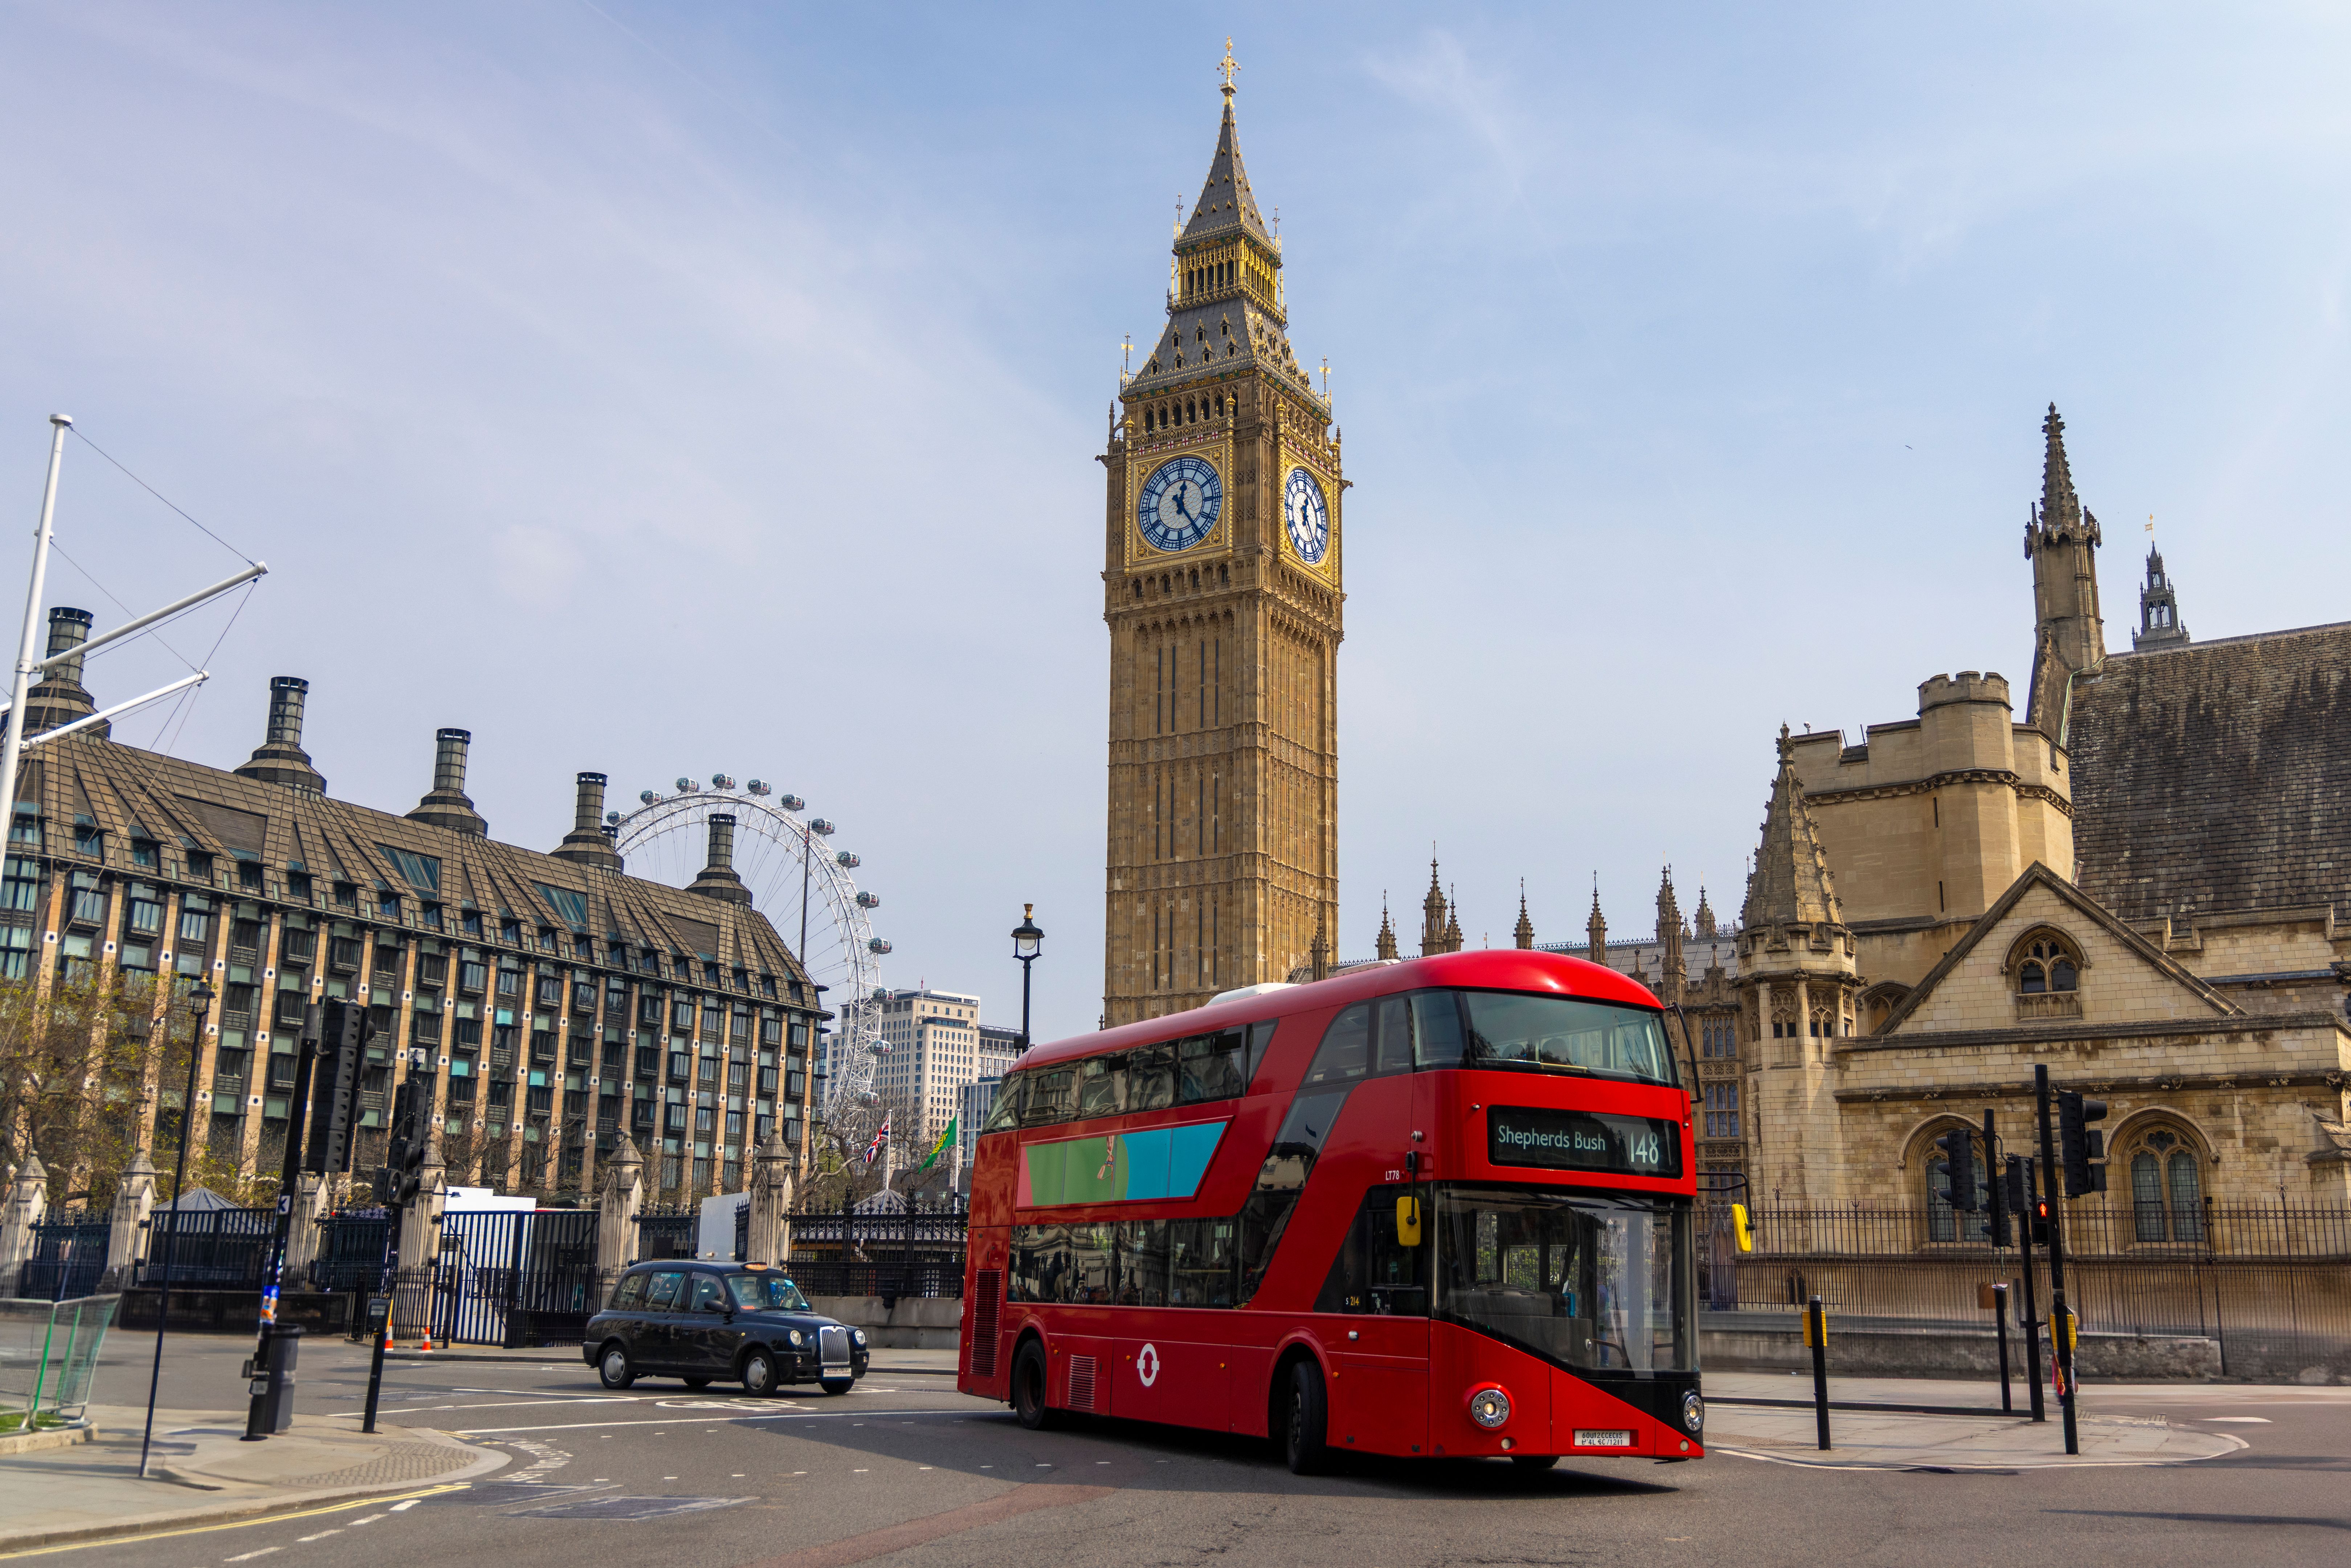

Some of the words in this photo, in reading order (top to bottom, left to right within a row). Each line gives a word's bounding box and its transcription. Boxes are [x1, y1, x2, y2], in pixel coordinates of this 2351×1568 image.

[1498, 1125, 1570, 1150] Shepherds
[1575, 1131, 1605, 1151] Bush
[1630, 1131, 1658, 1164] 148
[1385, 1170, 1399, 1180] LT78
[1350, 1296, 1359, 1306] 214
